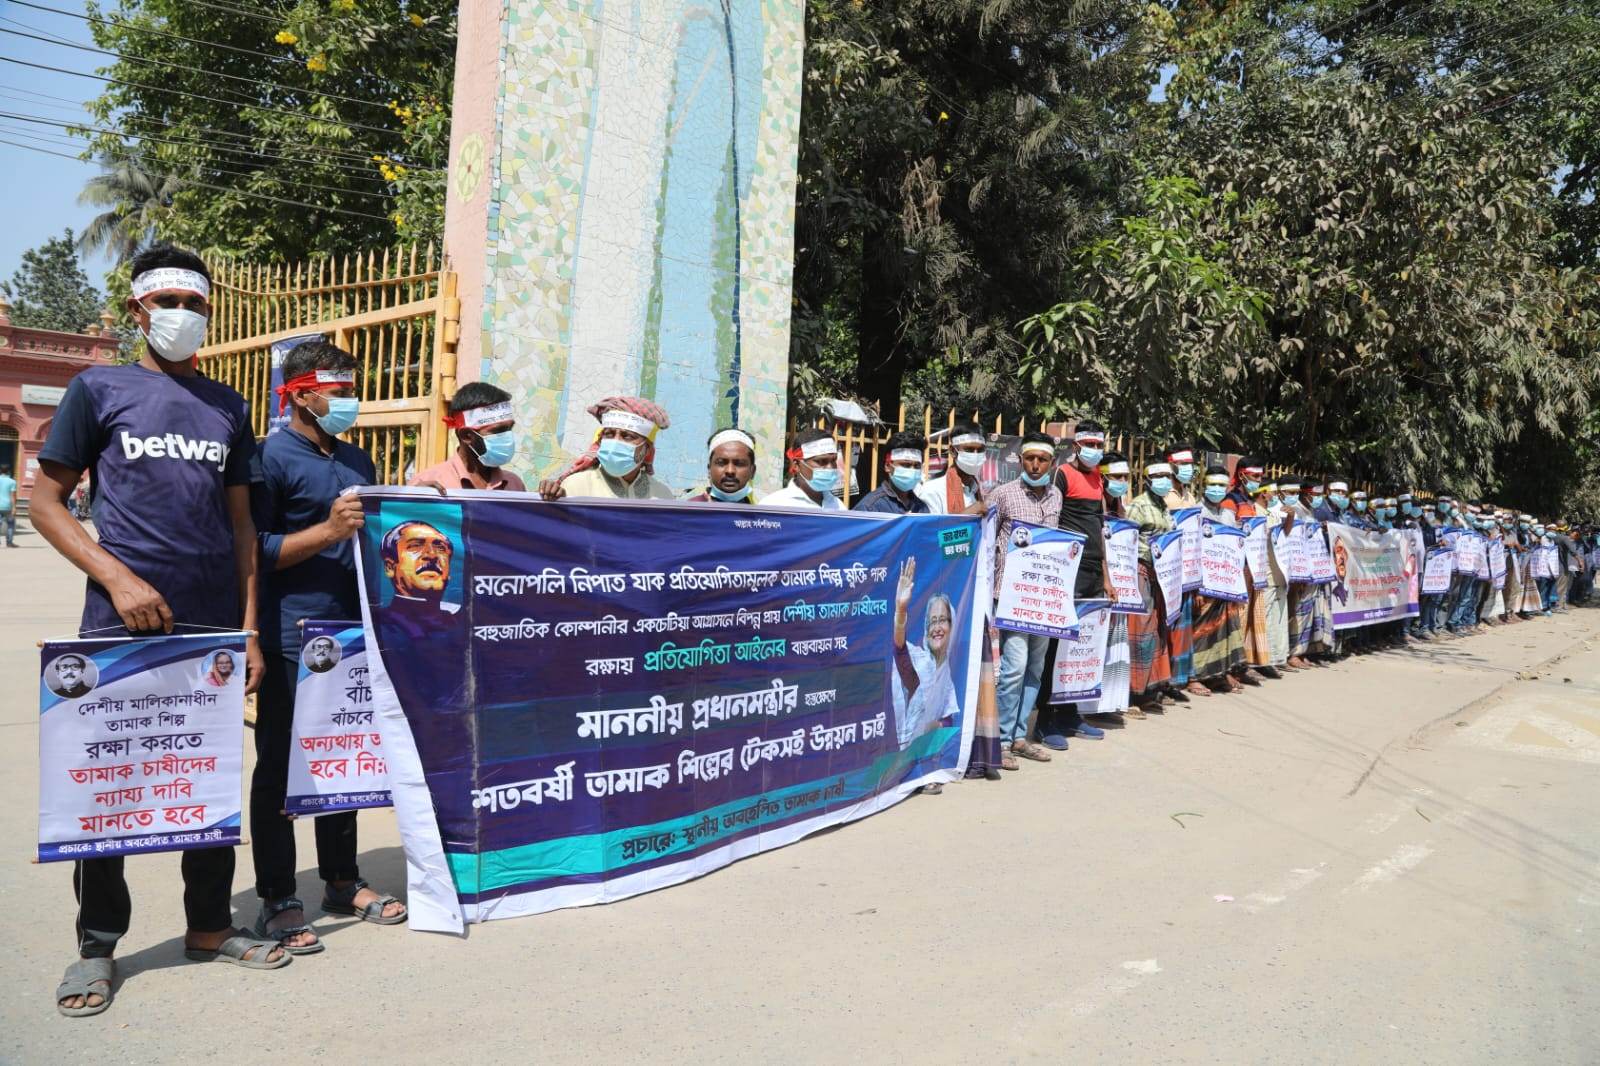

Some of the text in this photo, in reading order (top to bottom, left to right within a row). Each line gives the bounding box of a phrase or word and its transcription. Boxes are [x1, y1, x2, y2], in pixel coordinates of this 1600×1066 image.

[121, 431, 230, 472] betway
[474, 567, 565, 596] মনোপলি
[570, 567, 626, 594] নিপাত
[630, 572, 665, 591] যাক
[669, 564, 779, 592] প্রতিযোগিতামূলক
[780, 570, 816, 587] তামাক
[818, 563, 844, 588] শিল্প
[844, 562, 868, 588] মুক্তি
[474, 595, 888, 641] বহুজাতিক কোম্পানীর একচেটিয়া আগ্রাসনে বিপন্ন প্রায় দেশীয় তামাক চাষীদের
[585, 635, 848, 676] রক্ষায় প্রতিযোগিতা আইনের বাস্তবায়ন সহ
[78, 690, 218, 717] দেশীয় মালিকানাধীন
[331, 707, 374, 727] বাঁচবে
[576, 694, 684, 739] মাননীয়
[692, 678, 799, 730] প্রধানমন্ত্রীর
[105, 711, 188, 733] তামাক শিল্প
[84, 732, 205, 760] রক্ষা করতে
[300, 733, 366, 752] অন্যথায়
[67, 754, 218, 785] তামাক চাষীদের
[309, 758, 350, 779] হবে
[471, 712, 887, 813] শতবর্ষী তামাক শিল্পের টেকসই উন্নয়ন চাই
[94, 777, 194, 808] ন্যায্য দাবি
[723, 798, 780, 829] অবহেলিত
[783, 788, 822, 812] তামাক
[824, 776, 845, 800] চাষী
[78, 803, 208, 833] মানতে হবে
[124, 833, 169, 849] অবহেলিত
[172, 833, 201, 844] তামাক
[203, 829, 223, 841] চাষী
